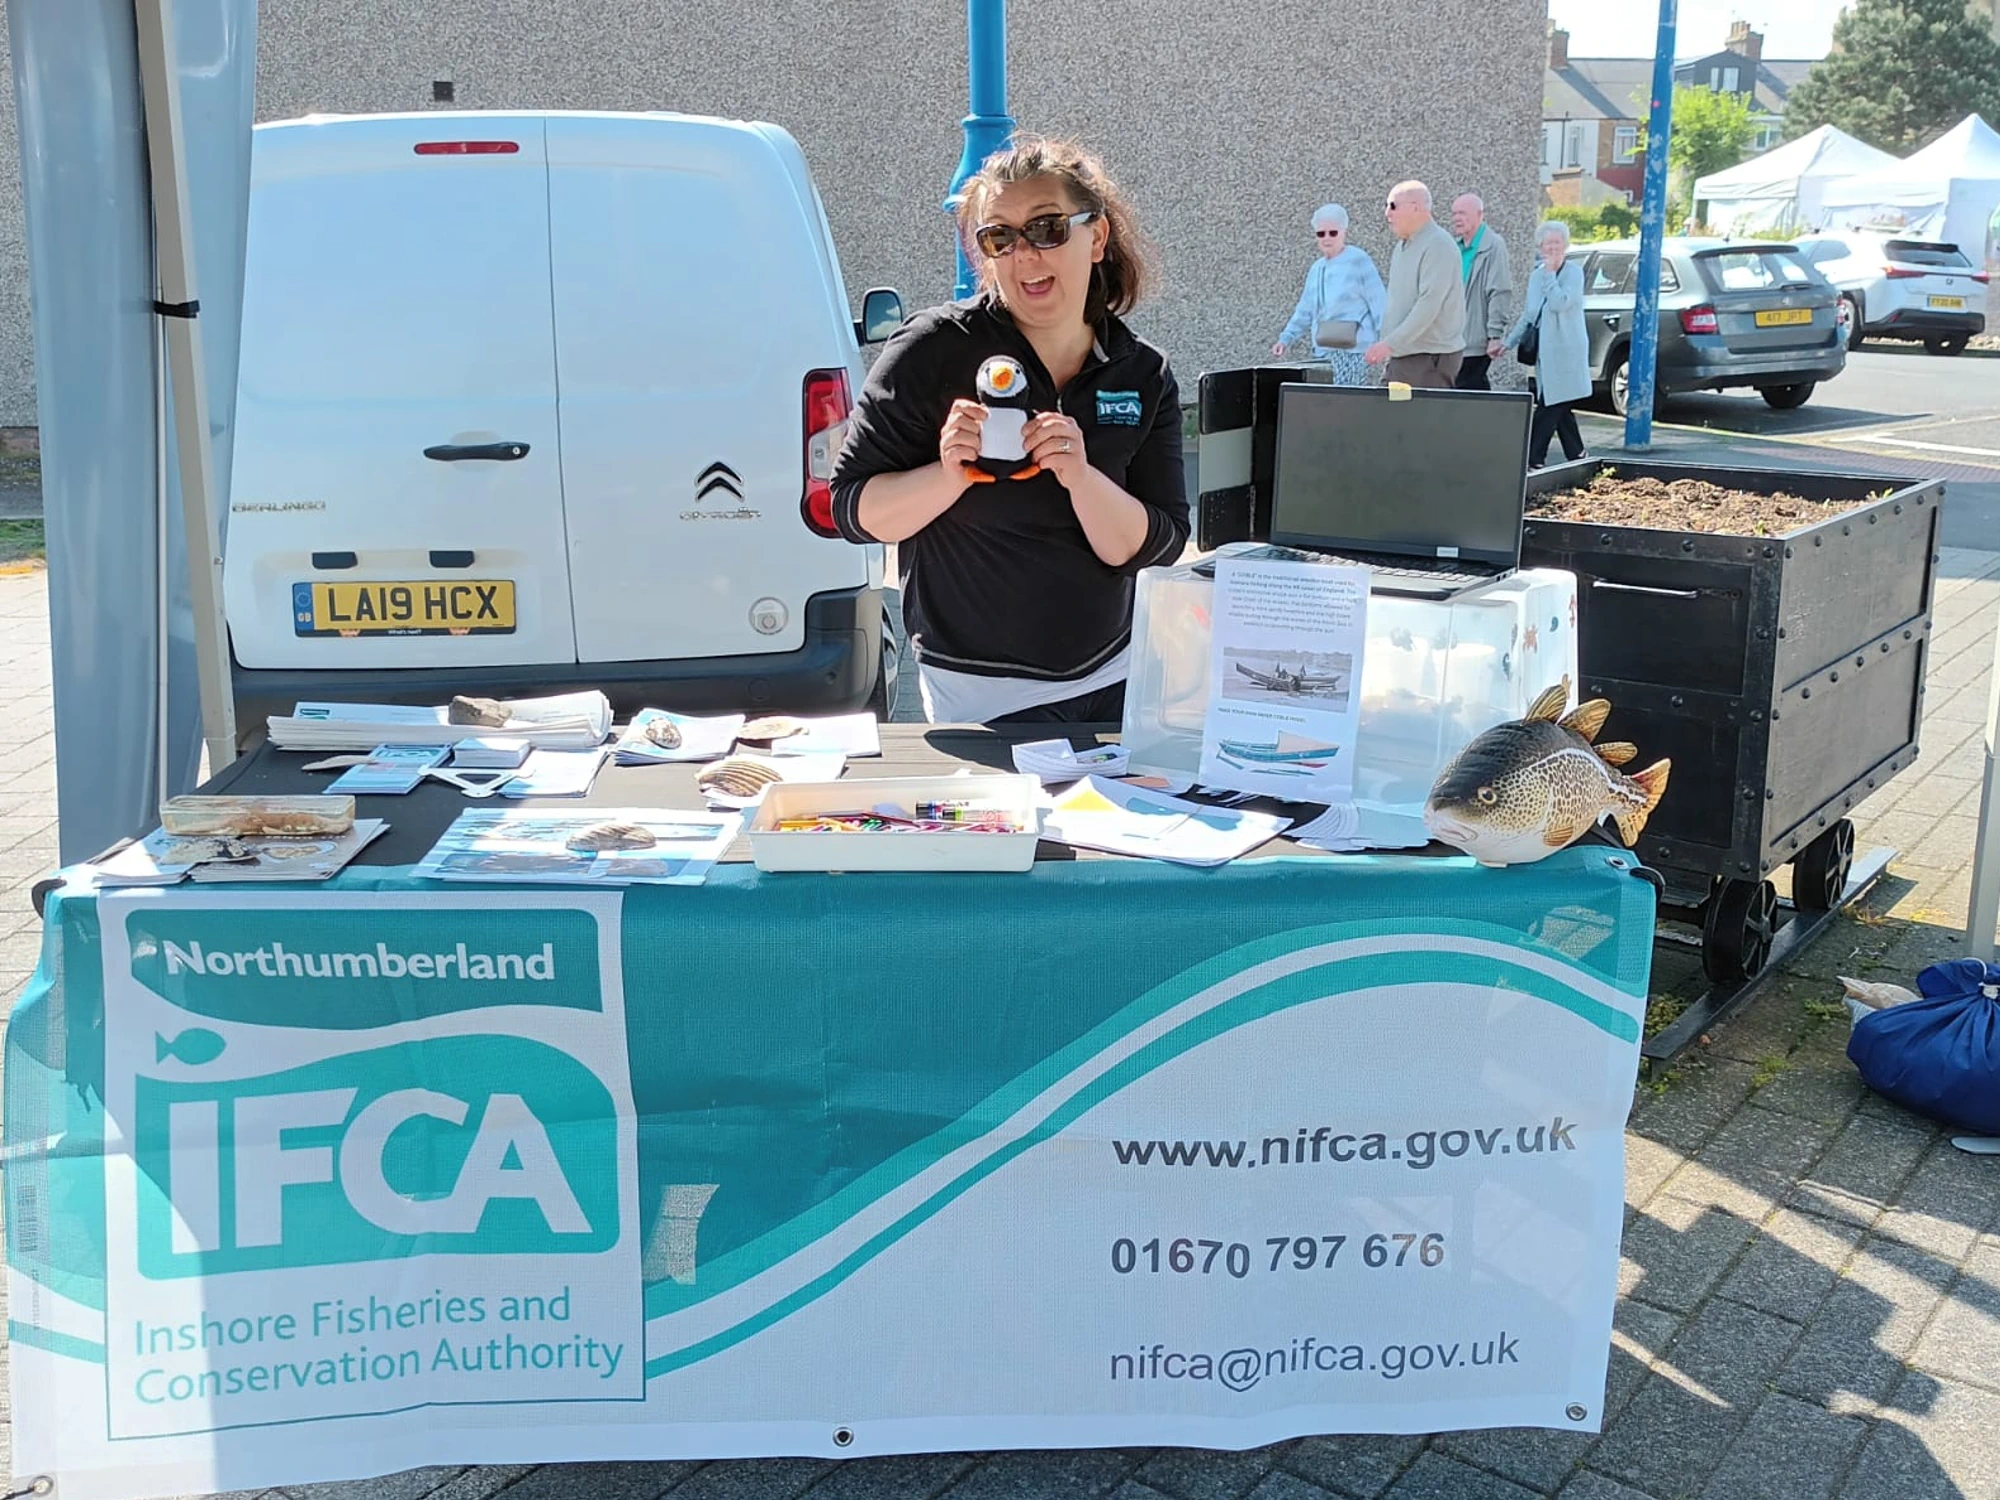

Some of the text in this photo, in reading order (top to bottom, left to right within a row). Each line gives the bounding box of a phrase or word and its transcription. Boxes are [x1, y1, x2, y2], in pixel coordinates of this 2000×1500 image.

[1099, 401, 1141, 417] IFCA
[328, 585, 499, 621] LA19 HCX
[164, 939, 556, 982] Northumberland
[1112, 1117, 1580, 1170] www.nifca.gov.uk
[168, 1087, 594, 1255] IFCA
[1111, 1232, 1445, 1279] 01670 797 676
[135, 1286, 571, 1357] Inshore Fisheries and
[134, 1334, 624, 1406] Conservation Authority
[1111, 1330, 1521, 1393] nifca@nifca.gov.uk
